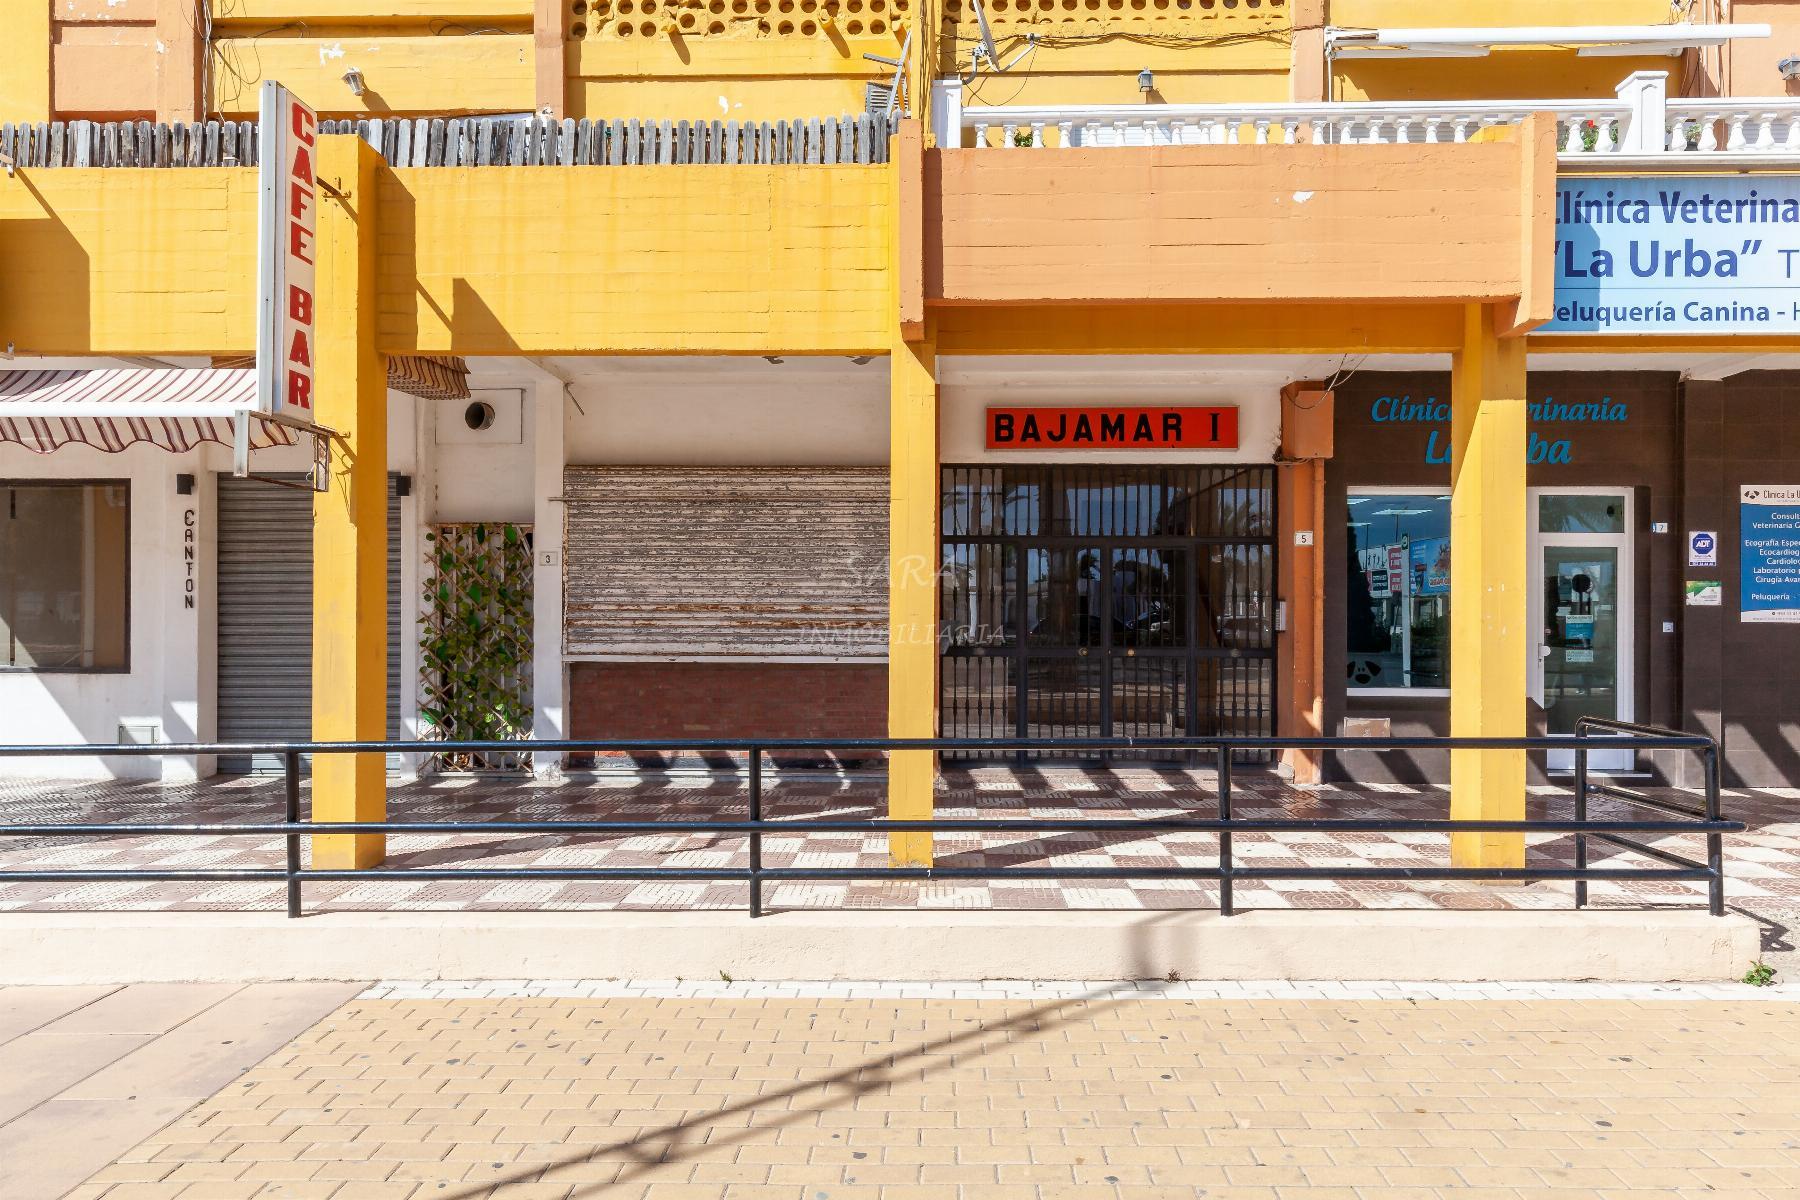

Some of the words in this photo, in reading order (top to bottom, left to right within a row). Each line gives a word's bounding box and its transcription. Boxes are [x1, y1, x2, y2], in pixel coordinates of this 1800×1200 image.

[289, 102, 314, 265] CAFE
[1659, 190, 1800, 224] Veterina
[1553, 301, 1676, 326] eluquería
[1683, 301, 1769, 322] Canina
[288, 284, 313, 409] BAR
[1528, 395, 1628, 422] rinaria
[994, 413, 1183, 443] BAJAMAR
[1209, 412, 1221, 442] I
[1301, 534, 1307, 544] 5
[1695, 540, 1711, 548] ADT
[184, 509, 195, 609] CANTON
[545, 554, 551, 564] 3
